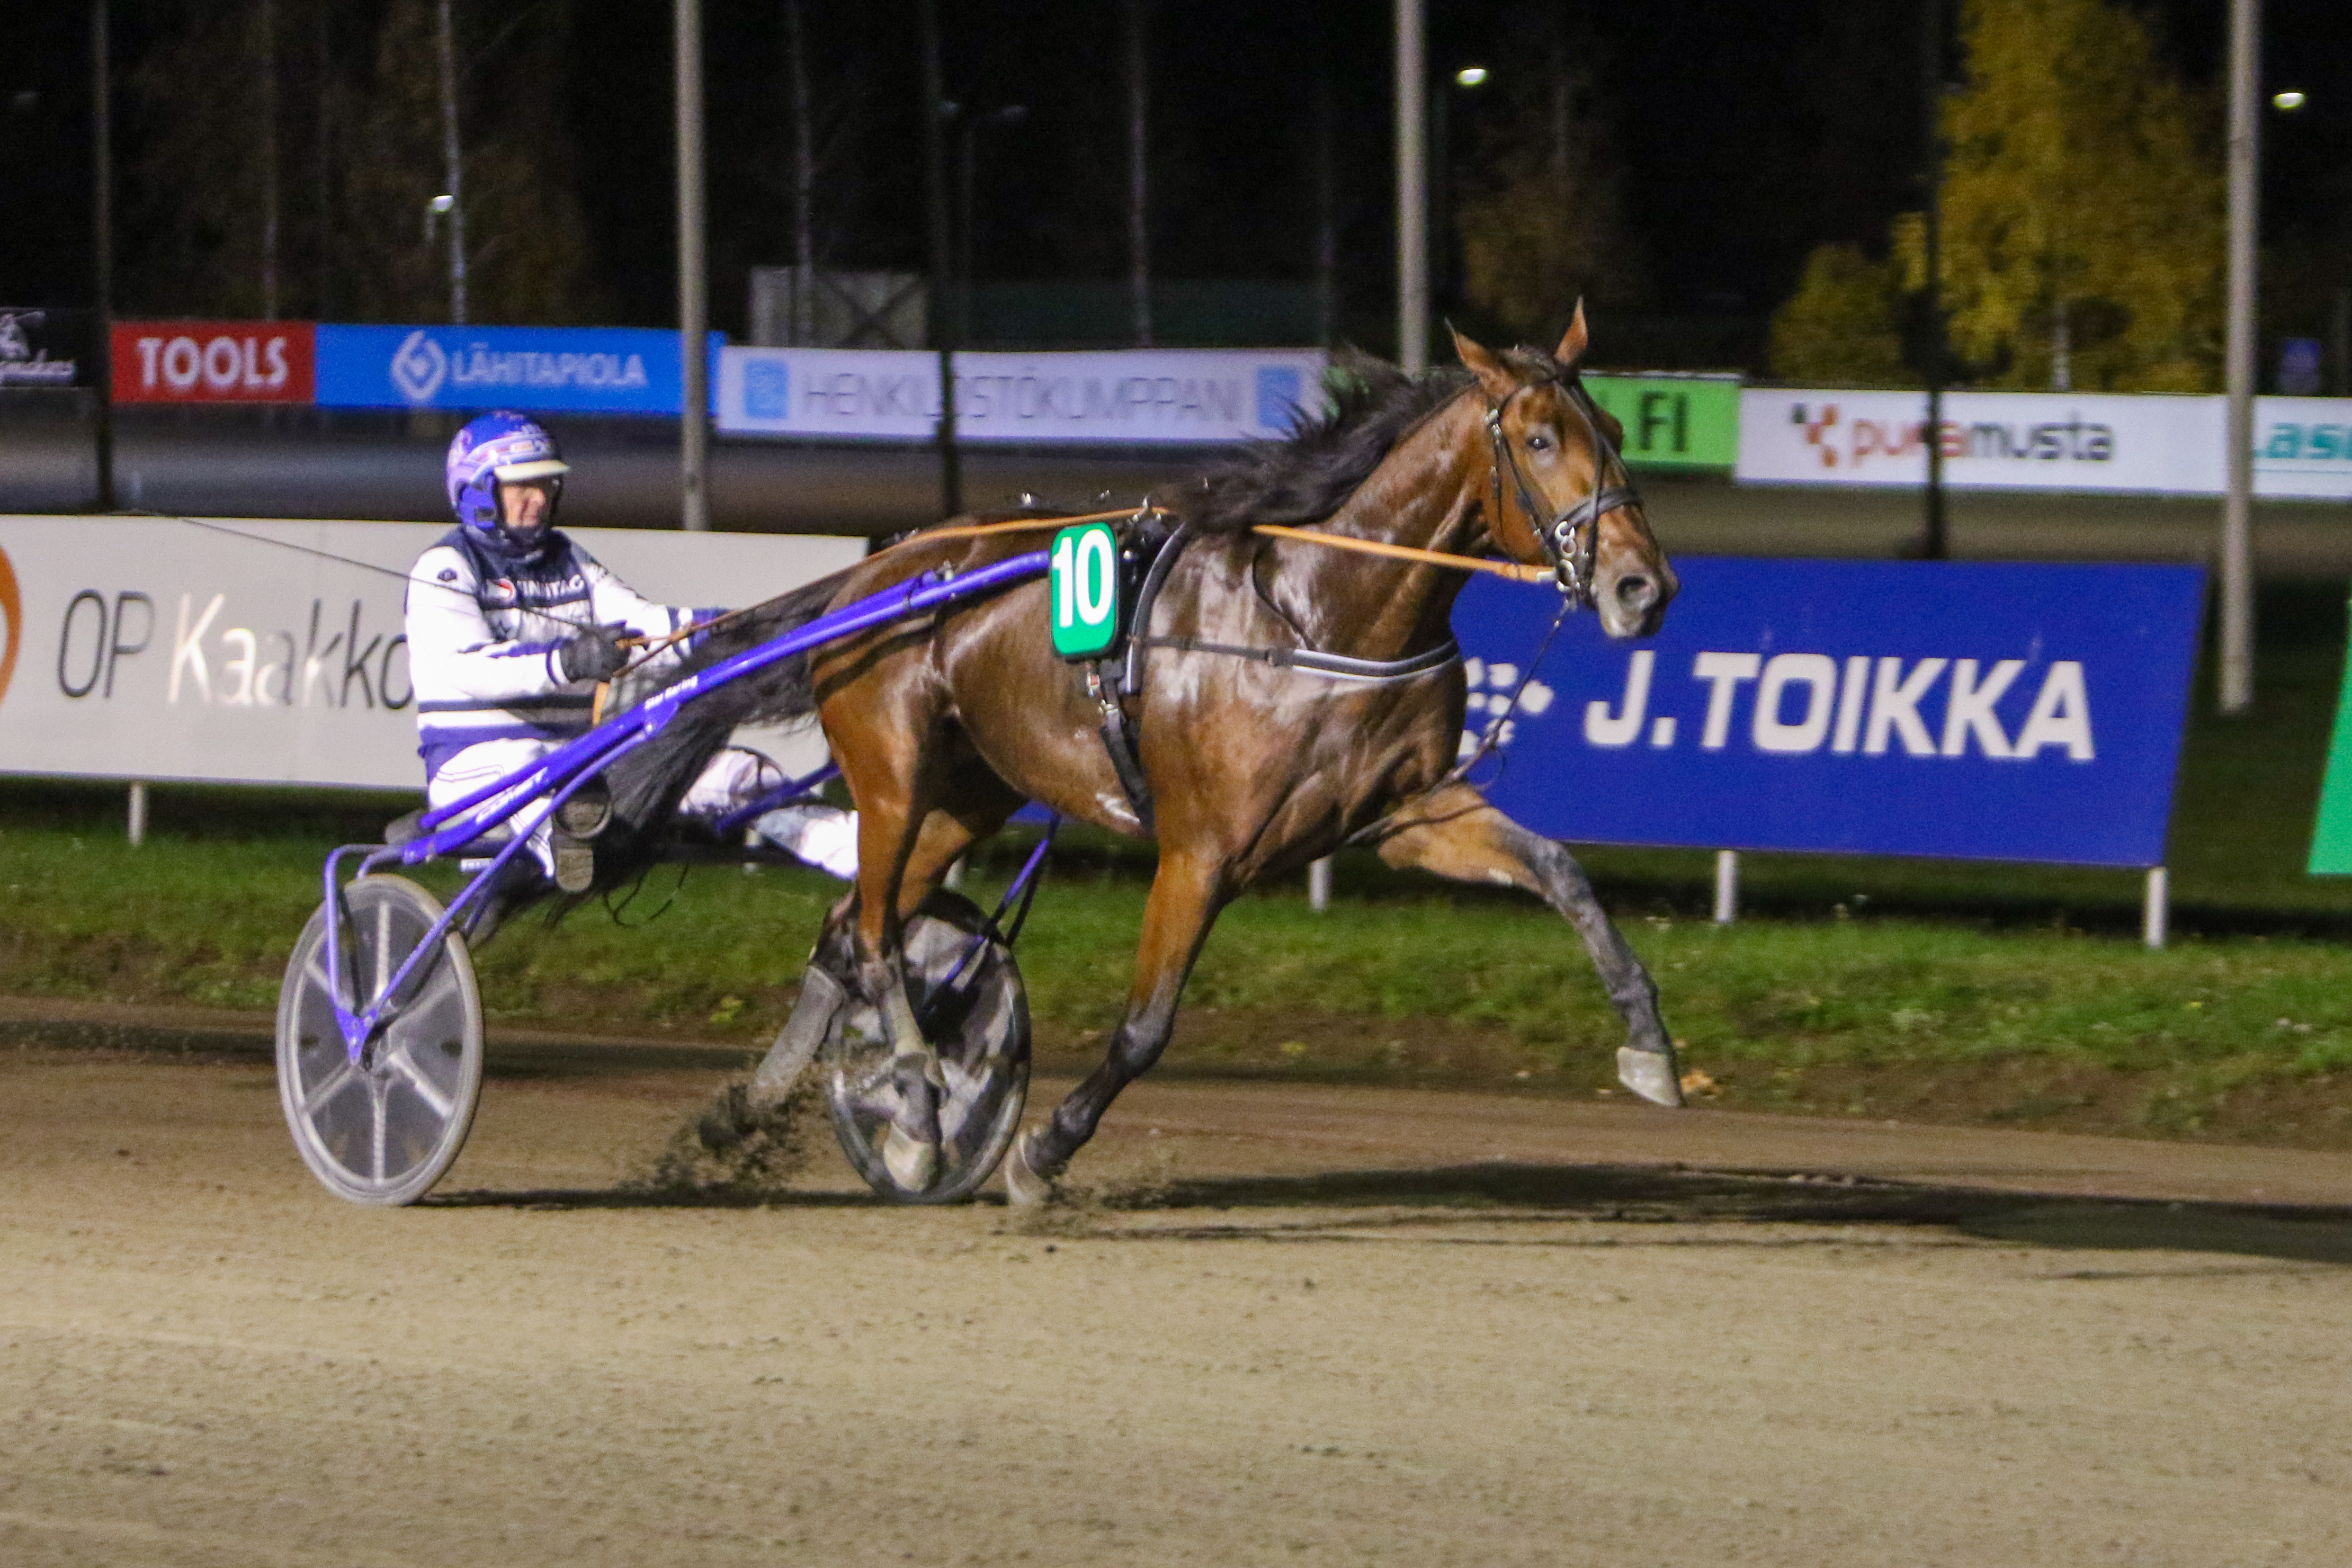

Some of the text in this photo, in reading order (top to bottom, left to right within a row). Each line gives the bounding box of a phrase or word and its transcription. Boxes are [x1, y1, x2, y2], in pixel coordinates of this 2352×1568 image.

[137, 336, 288, 388] TOOLS
[451, 342, 649, 386] LÄHITAPIOLA
[1051, 529, 1114, 629] 10
[57, 588, 155, 698] OP
[1693, 651, 2096, 759] TOIKKA
